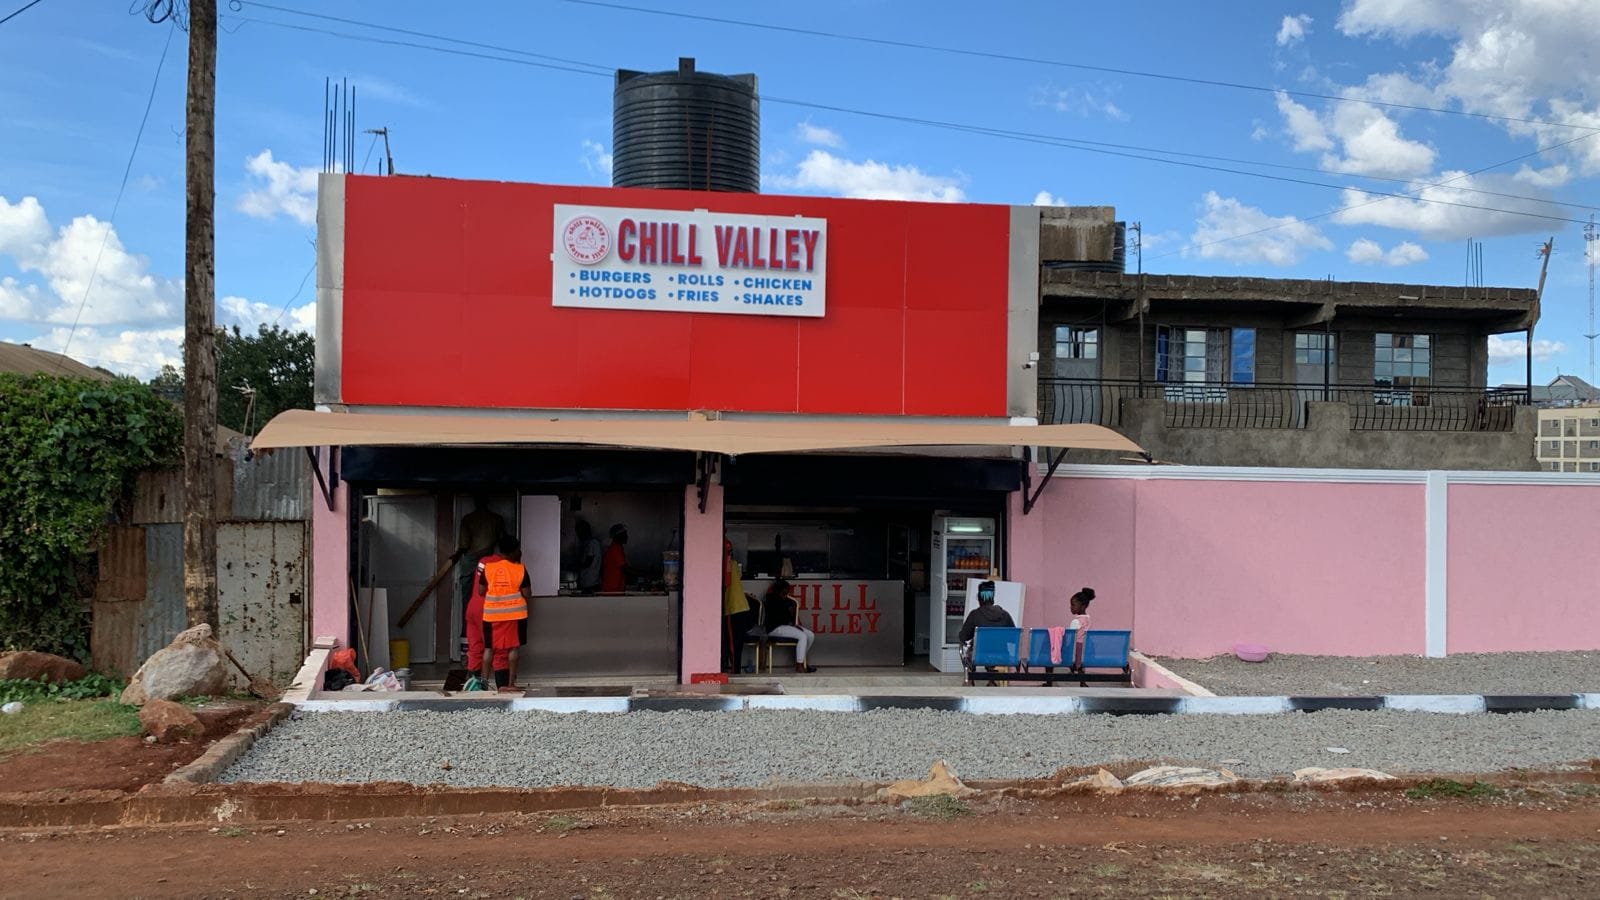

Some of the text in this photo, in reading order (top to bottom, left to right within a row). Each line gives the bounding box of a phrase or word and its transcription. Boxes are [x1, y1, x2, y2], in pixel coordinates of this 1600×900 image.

[618, 218, 820, 272] CHILL VALLEY
[579, 270, 652, 284] BURGERS
[677, 273, 724, 287] ROLLS
[743, 277, 812, 291] CHICKEN
[579, 286, 656, 300] HOTDOGS
[677, 289, 719, 302] FRIES
[742, 293, 803, 306] SHAKES
[768, 584, 876, 610] HILL
[798, 613, 881, 634] LLEY
